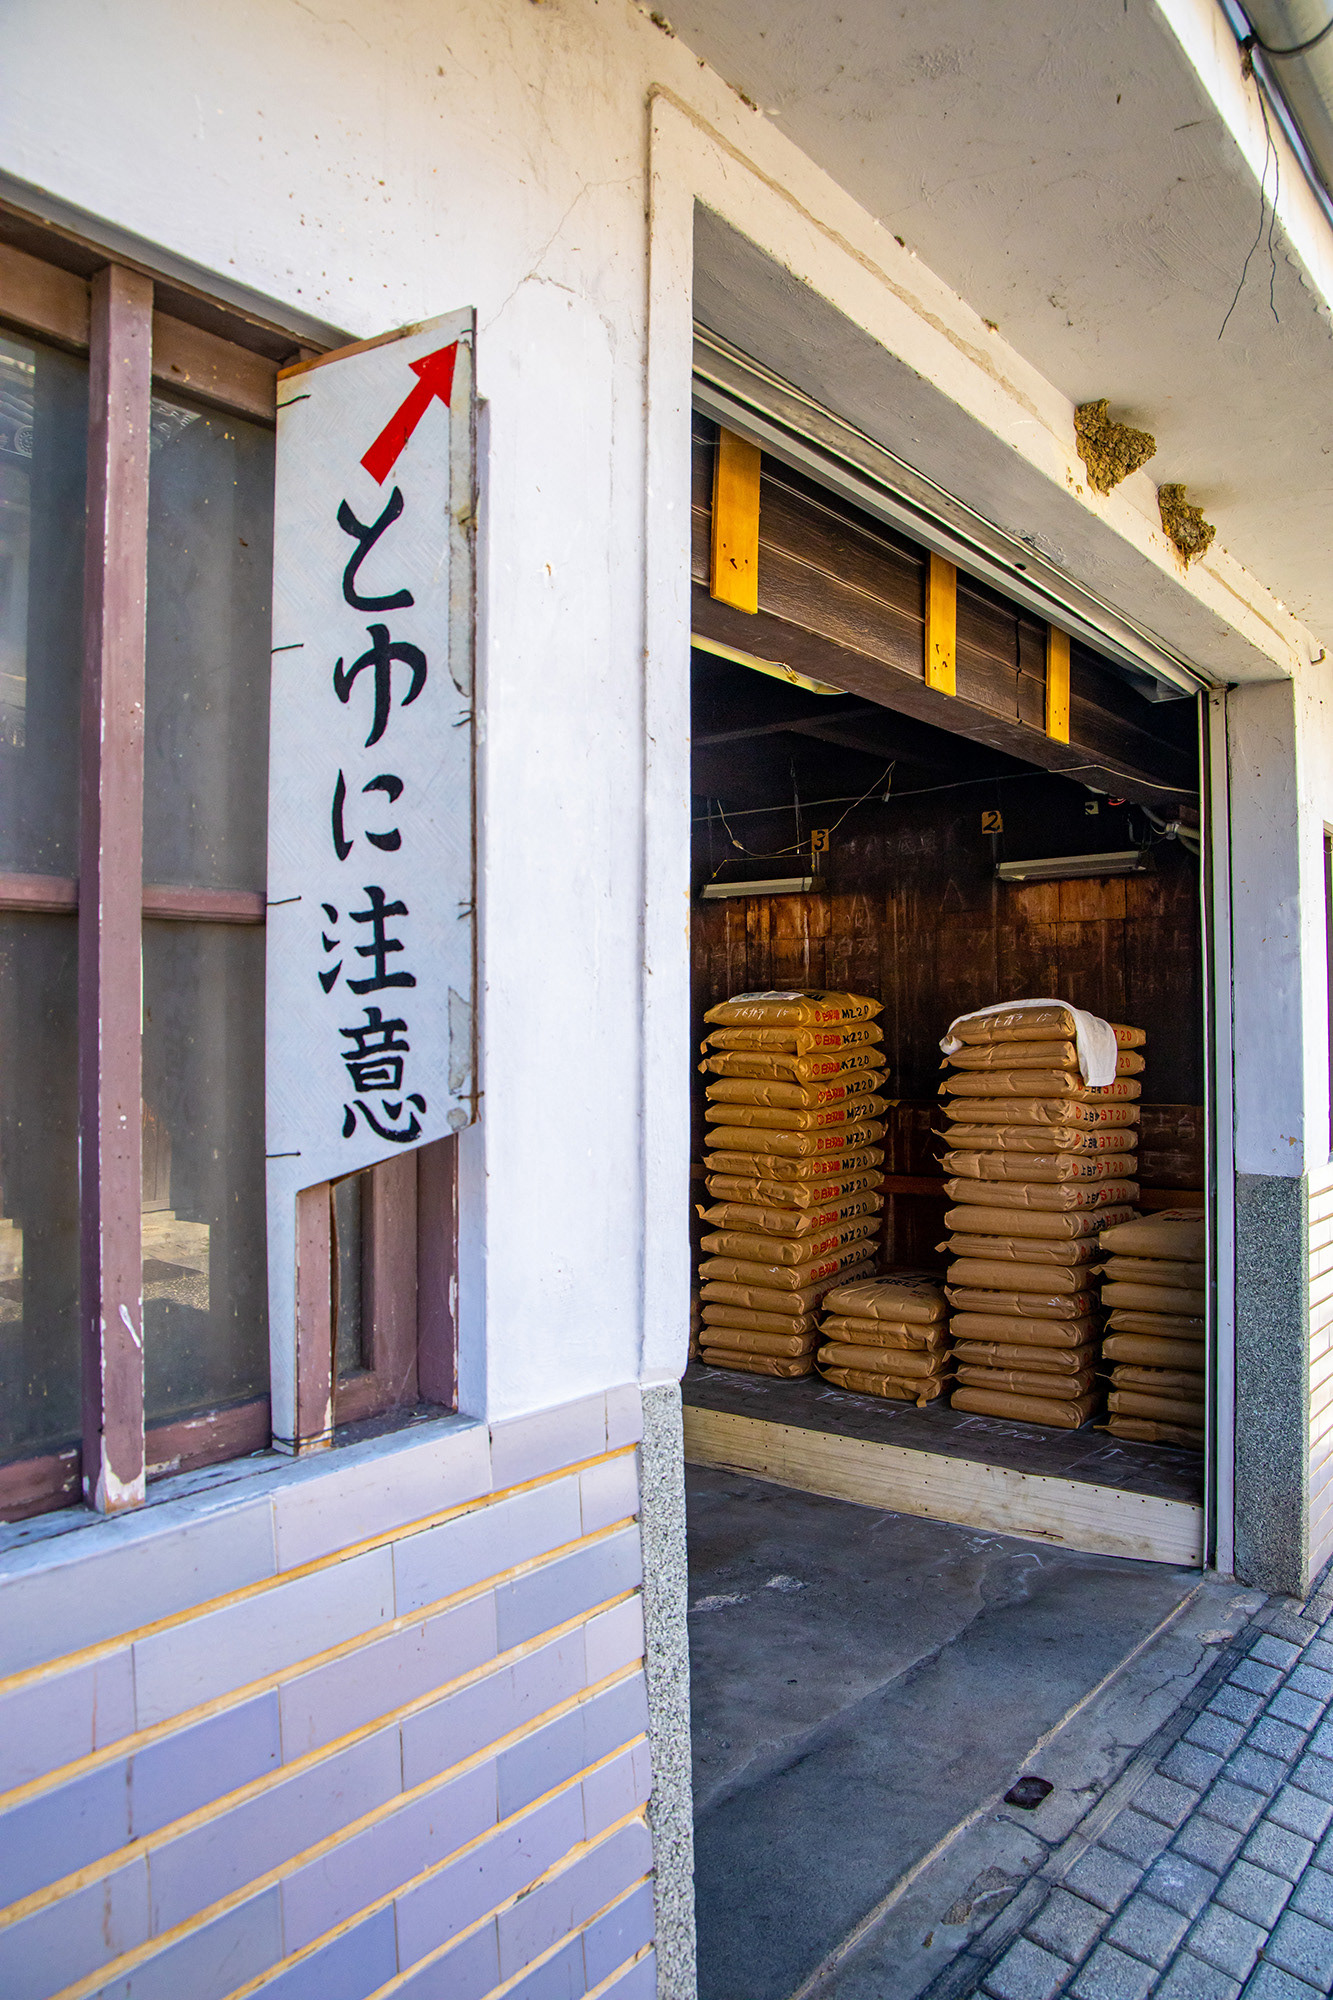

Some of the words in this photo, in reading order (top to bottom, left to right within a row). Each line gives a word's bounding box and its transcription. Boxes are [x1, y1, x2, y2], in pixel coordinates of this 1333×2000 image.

[983, 811, 1001, 832] 2
[813, 830, 826, 851] 3
[842, 1005, 869, 1018] MZ20
[846, 1079, 872, 1095] MZ20
[1103, 1084, 1128, 1095] ST20
[847, 1104, 874, 1119] MZ20
[1100, 1109, 1127, 1120] ST20
[846, 1130, 872, 1145] MZ20
[1099, 1136, 1124, 1147] ST20
[842, 1156, 867, 1169] MZ20
[1097, 1162, 1124, 1173] ST20
[841, 1178, 868, 1194] MZ20
[1100, 1188, 1127, 1201] ST20
[840, 1202, 867, 1219] MZ20
[840, 1225, 868, 1244] MZ20
[840, 1248, 867, 1268] MZ20
